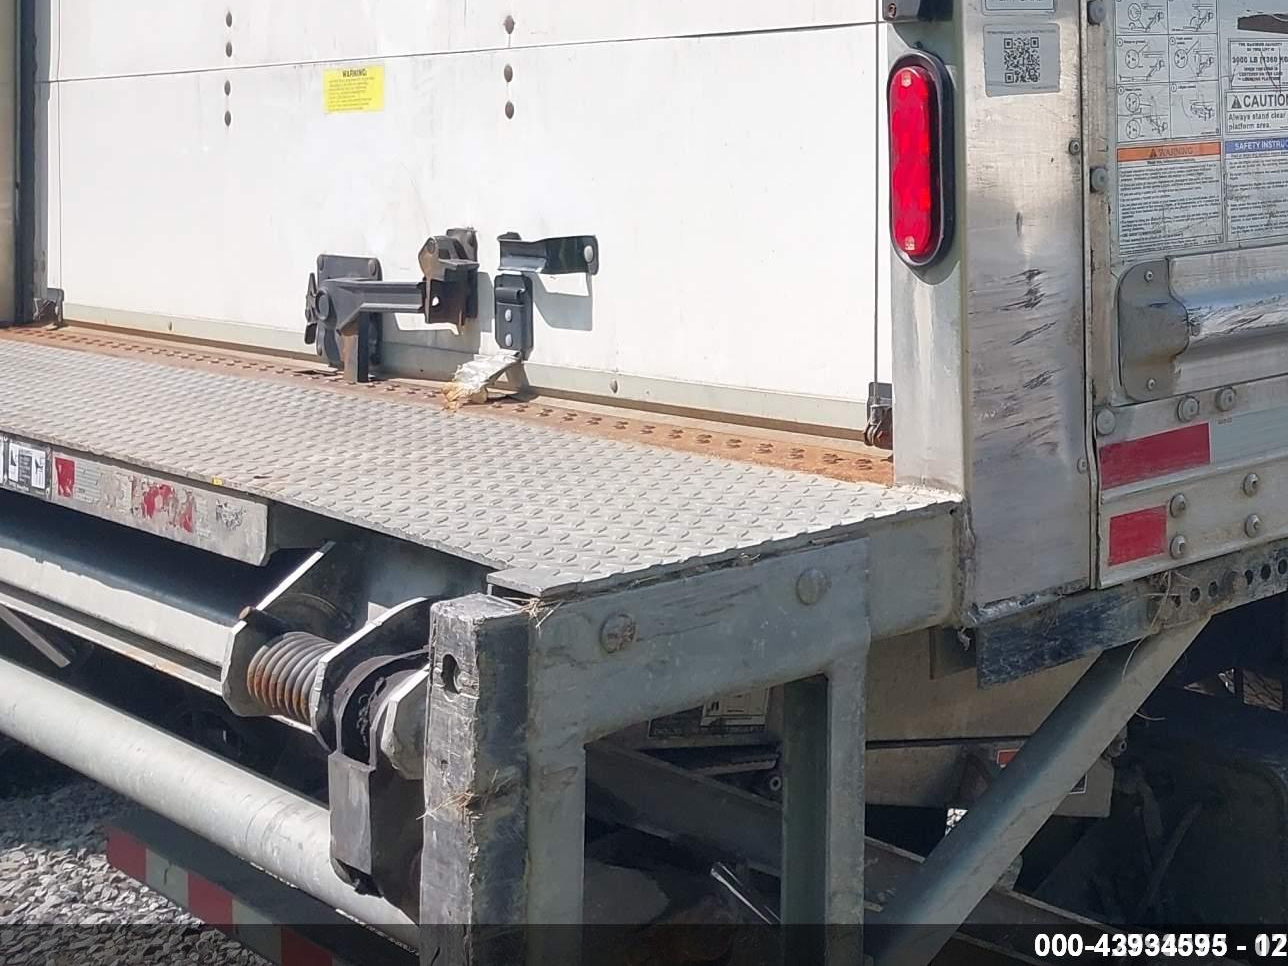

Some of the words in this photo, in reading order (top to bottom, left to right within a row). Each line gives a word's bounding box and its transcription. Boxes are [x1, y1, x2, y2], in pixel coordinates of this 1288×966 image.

[1231, 56, 1248, 64] 3000
[1249, 56, 1258, 64] LB
[1228, 113, 1251, 122] Always
[1252, 112, 1270, 121] stand
[1270, 111, 1286, 119] clear
[1228, 122, 1255, 131] platform
[1235, 141, 1260, 151] SAFETY
[1158, 147, 1194, 157] WARNING
